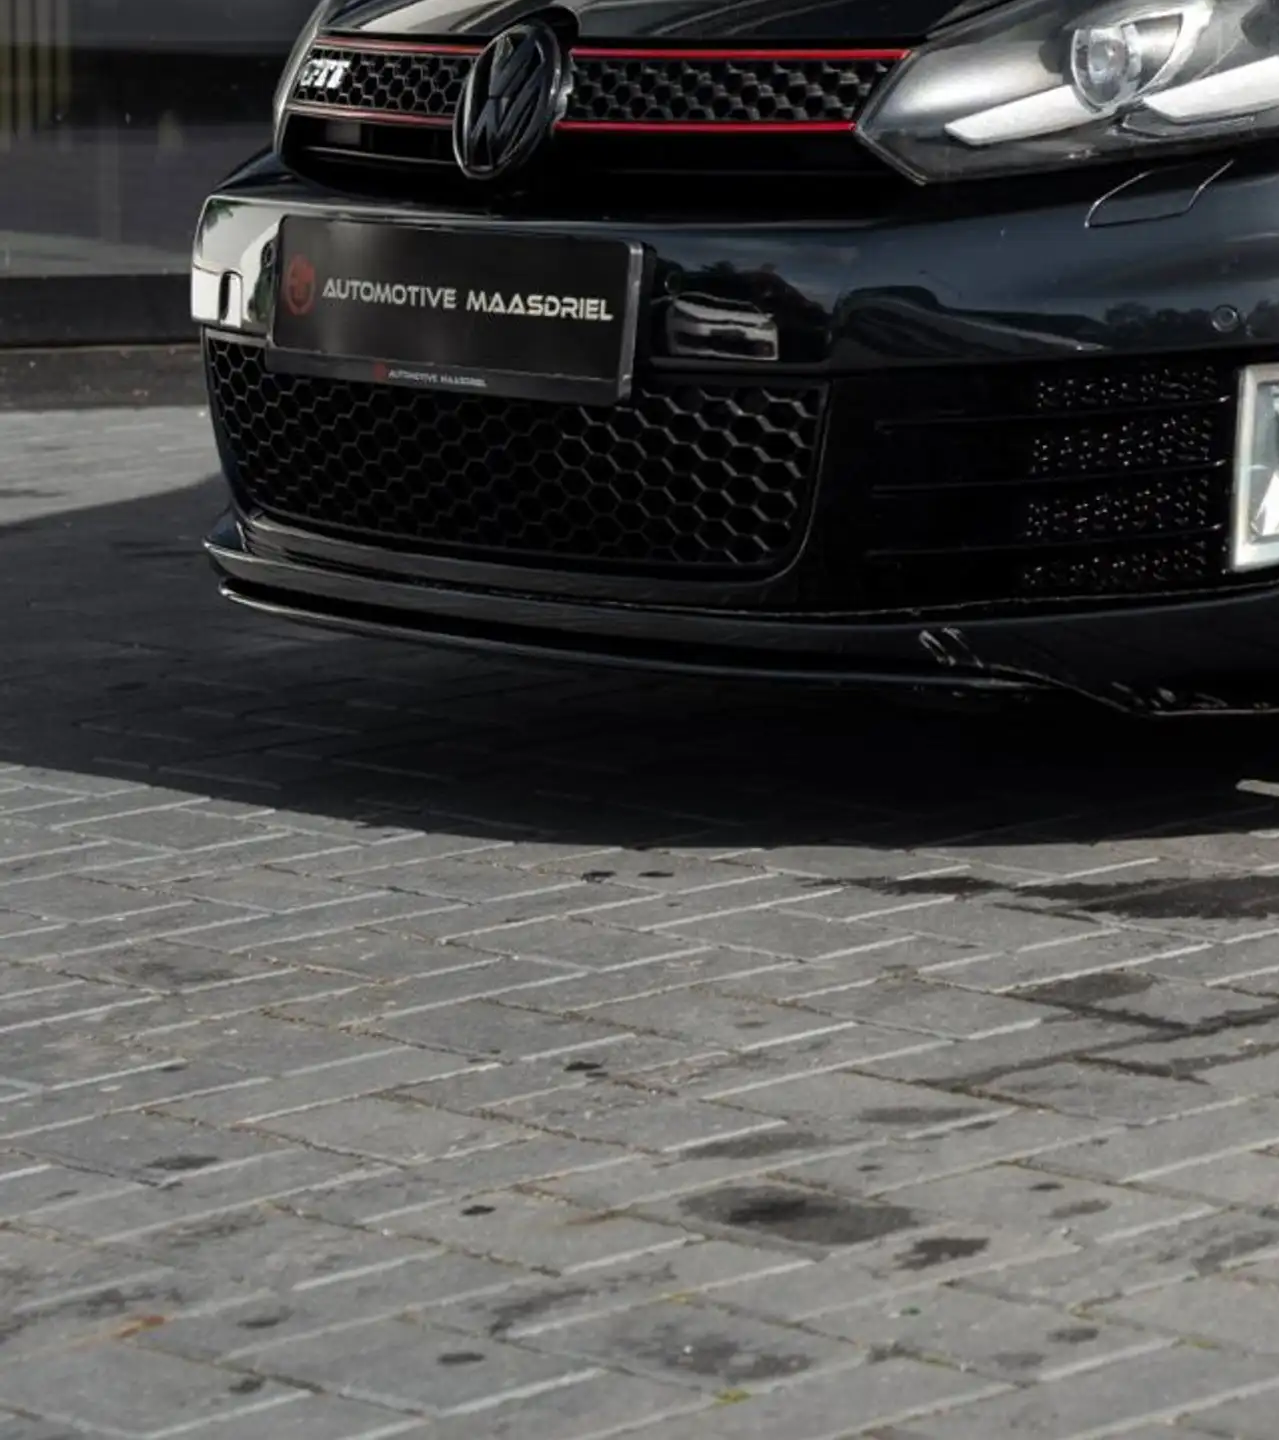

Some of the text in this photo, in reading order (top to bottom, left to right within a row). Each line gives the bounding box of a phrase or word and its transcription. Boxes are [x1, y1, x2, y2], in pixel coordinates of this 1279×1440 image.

[300, 58, 352, 89] GTI
[322, 277, 614, 322] AUTOMOTIVE MAASDRIEL
